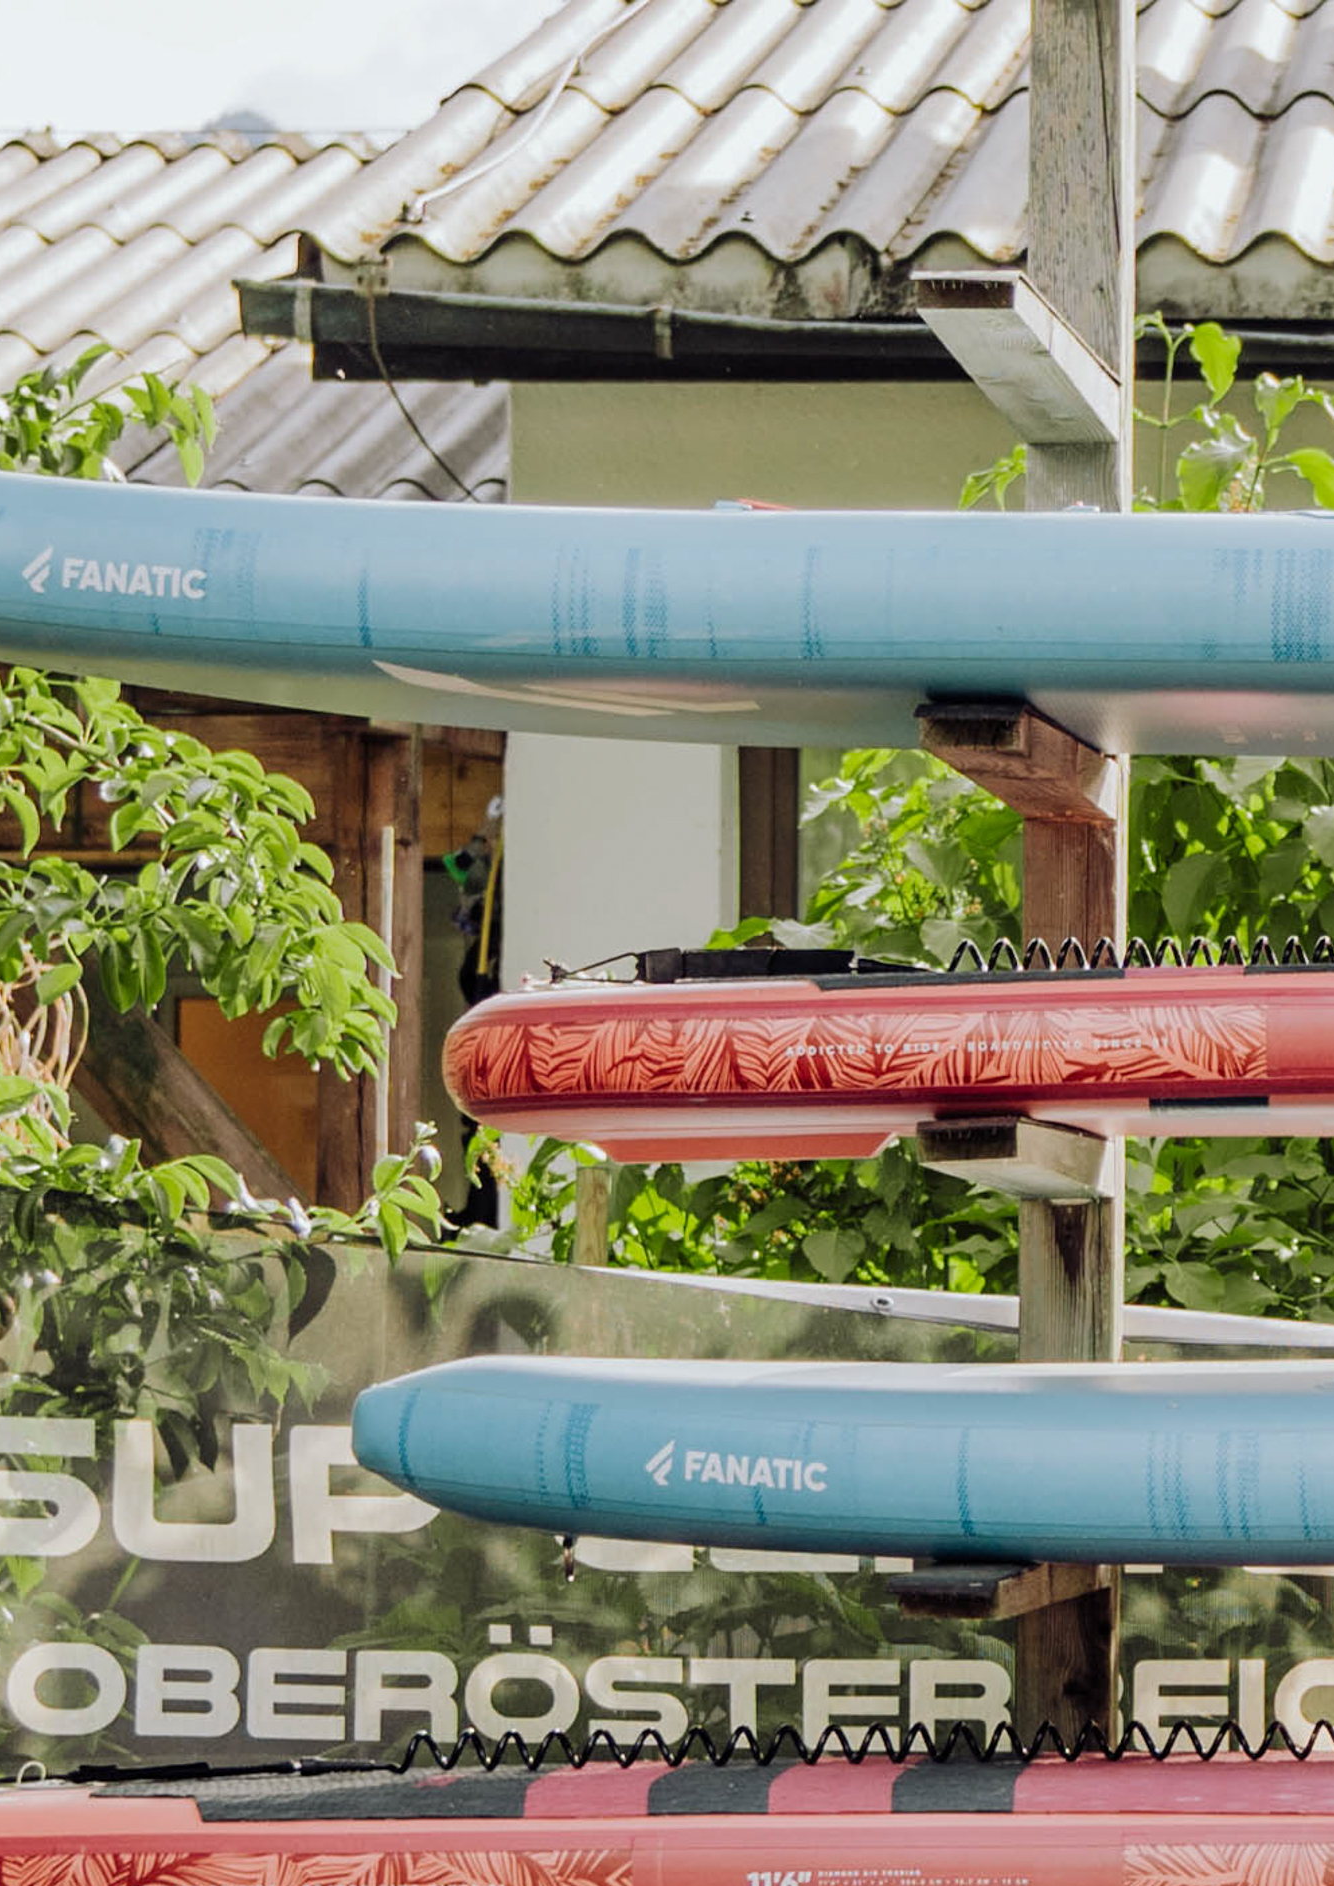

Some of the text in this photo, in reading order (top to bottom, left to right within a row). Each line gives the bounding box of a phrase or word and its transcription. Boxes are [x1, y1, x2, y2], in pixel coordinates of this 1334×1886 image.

[61, 556, 207, 601] FANATIC
[785, 1043, 866, 1056] ADDICTED
[874, 1042, 893, 1054] TO
[681, 1449, 828, 1493] FANATIC
